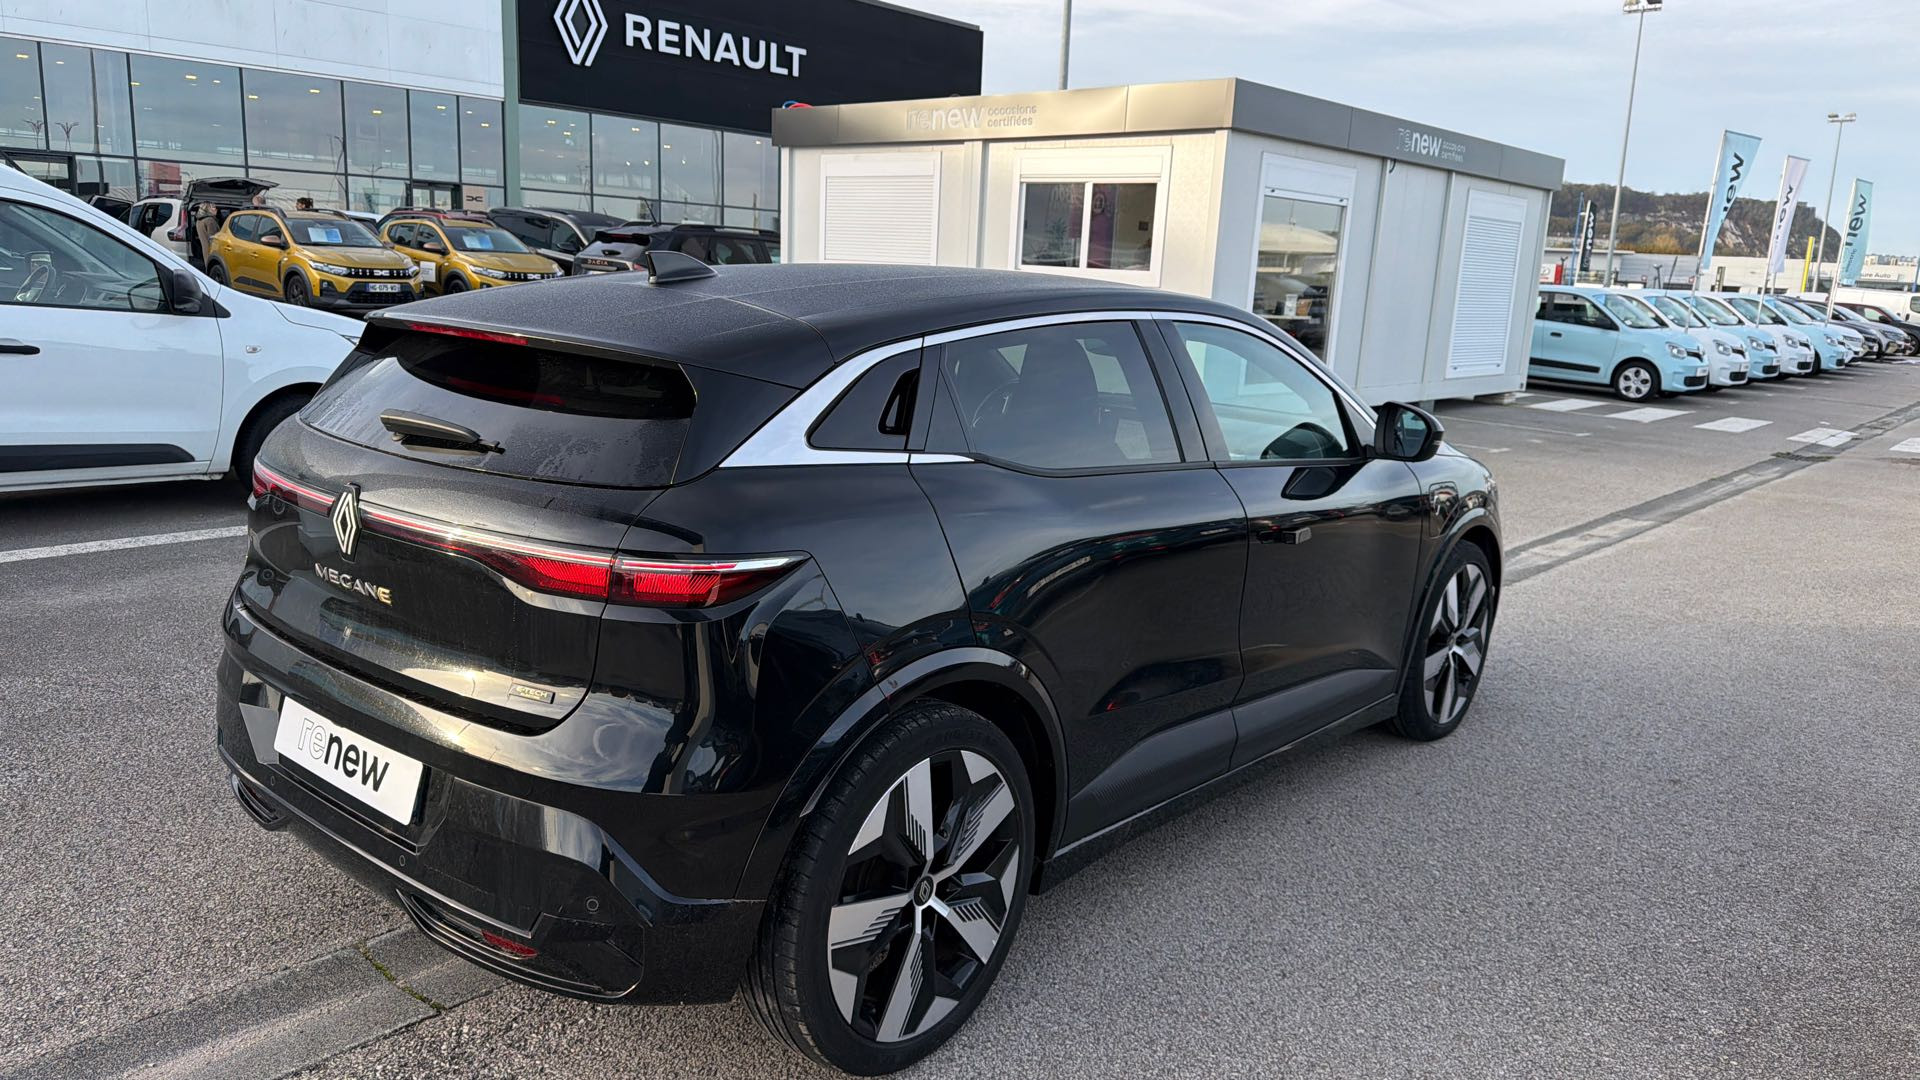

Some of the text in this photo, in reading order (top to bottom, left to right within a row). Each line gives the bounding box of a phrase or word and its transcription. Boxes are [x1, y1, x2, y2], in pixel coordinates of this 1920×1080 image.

[625, 12, 807, 77] RENAULT
[906, 105, 984, 130] renew
[988, 104, 1037, 116] occasions
[315, 563, 392, 606] MEGANE
[298, 717, 390, 792] renew
